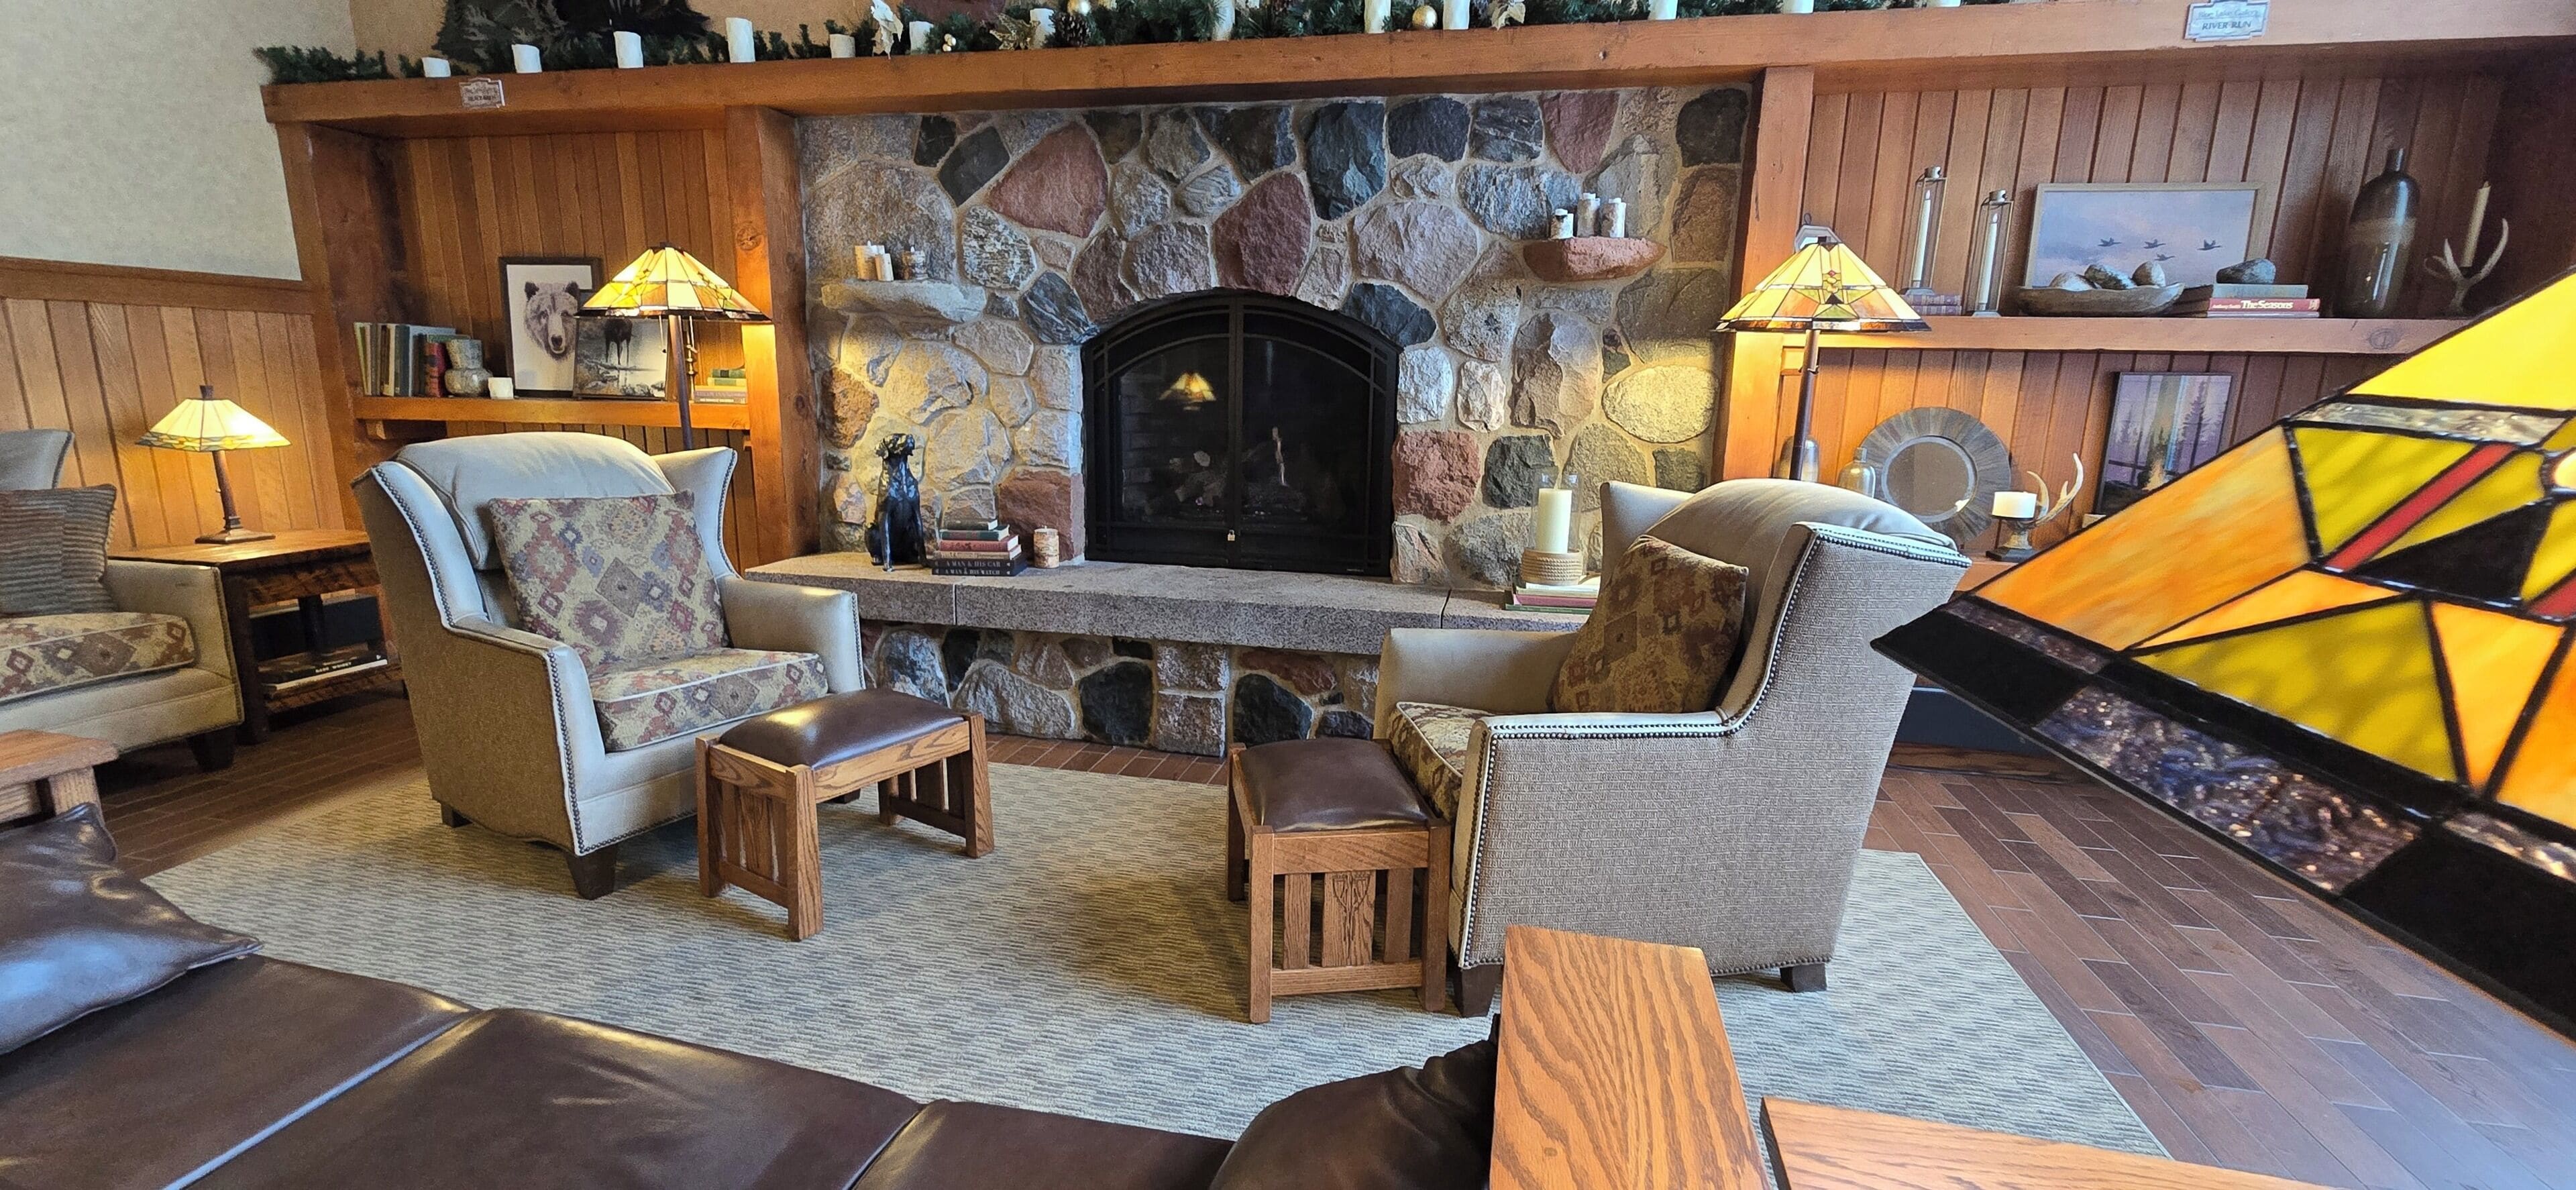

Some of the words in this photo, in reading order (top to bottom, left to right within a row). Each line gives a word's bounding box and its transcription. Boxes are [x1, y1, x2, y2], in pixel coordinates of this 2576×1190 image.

[2202, 21, 2229, 30] RIVER
[2241, 300, 2258, 309] The
[2258, 300, 2294, 309] Seasons
